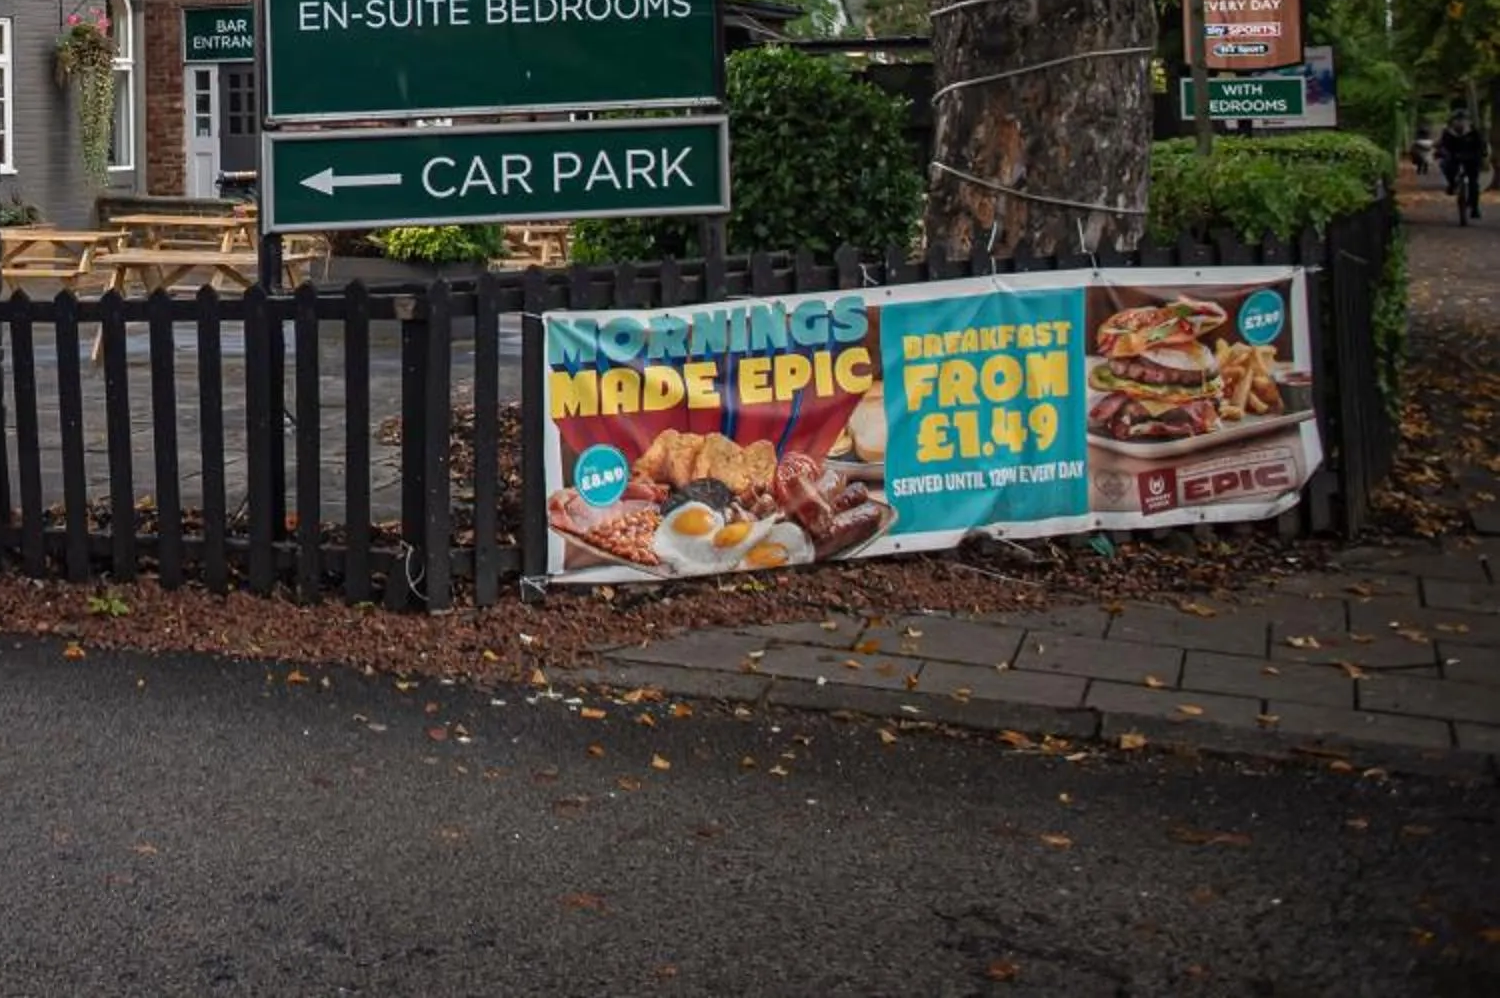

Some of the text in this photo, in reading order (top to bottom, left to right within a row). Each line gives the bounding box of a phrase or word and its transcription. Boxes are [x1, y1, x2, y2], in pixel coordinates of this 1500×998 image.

[193, 35, 253, 50] ENTRAN
[216, 19, 248, 33] BAR
[1209, 99, 1288, 113] EDROOMS
[1221, 83, 1263, 96] WITH
[421, 147, 695, 198] CAR PARK
[549, 296, 870, 365] MORNINGS
[903, 321, 1071, 360] BREAKFAST
[550, 347, 873, 419] MADE EPIC
[903, 350, 1069, 411] FROM
[916, 403, 1058, 463] £1.49
[892, 474, 943, 498] SERVED
[944, 471, 987, 491] UNTIL
[1019, 462, 1056, 483] EVERY
[1058, 460, 1084, 479] DAY
[1183, 463, 1289, 501] EPIC
